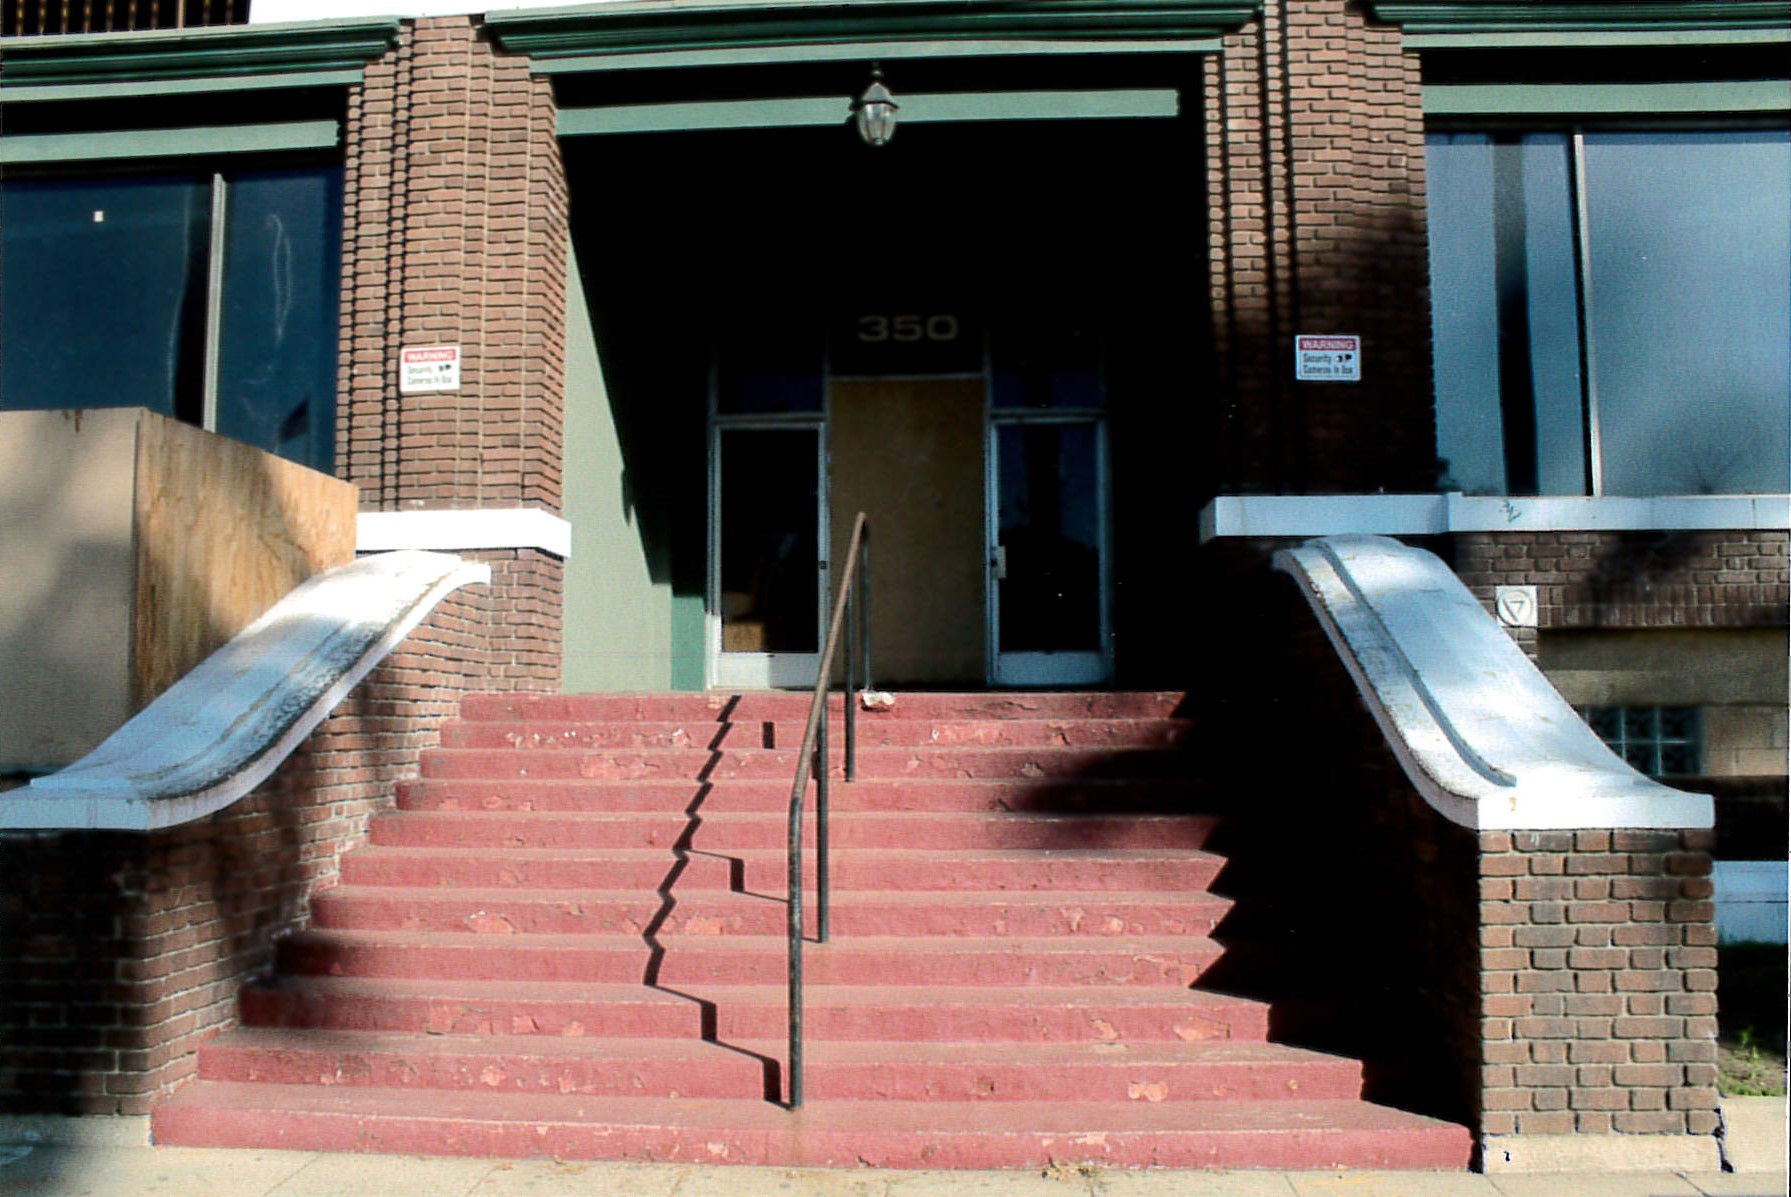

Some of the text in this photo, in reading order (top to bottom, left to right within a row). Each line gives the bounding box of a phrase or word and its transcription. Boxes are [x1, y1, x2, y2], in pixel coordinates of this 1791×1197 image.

[858, 315, 958, 342] 350
[1303, 339, 1354, 350] WARNING
[407, 351, 453, 361] WARNING
[1304, 353, 1332, 364] Security
[408, 365, 432, 375] Security
[1304, 365, 1332, 374] Cameras
[407, 376, 433, 385] Cameras
